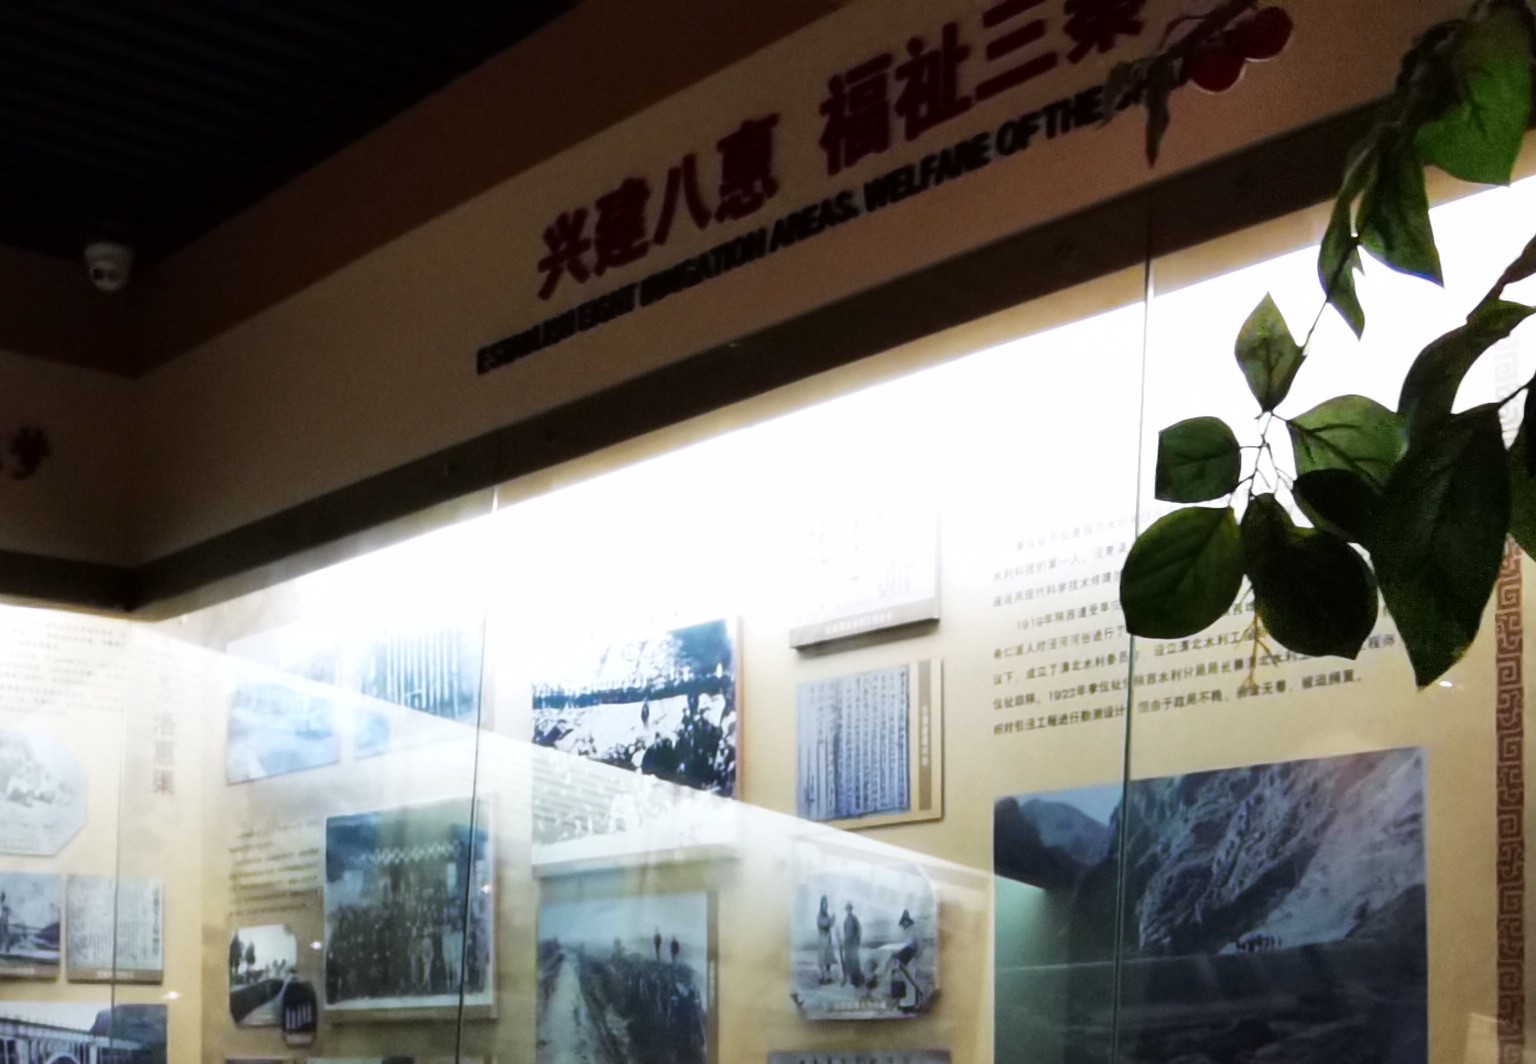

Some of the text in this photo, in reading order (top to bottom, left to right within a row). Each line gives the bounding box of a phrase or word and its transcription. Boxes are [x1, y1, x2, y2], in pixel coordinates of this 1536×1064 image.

[538, 113, 779, 300] 兴建八惠
[863, 133, 991, 212] WELFARE
